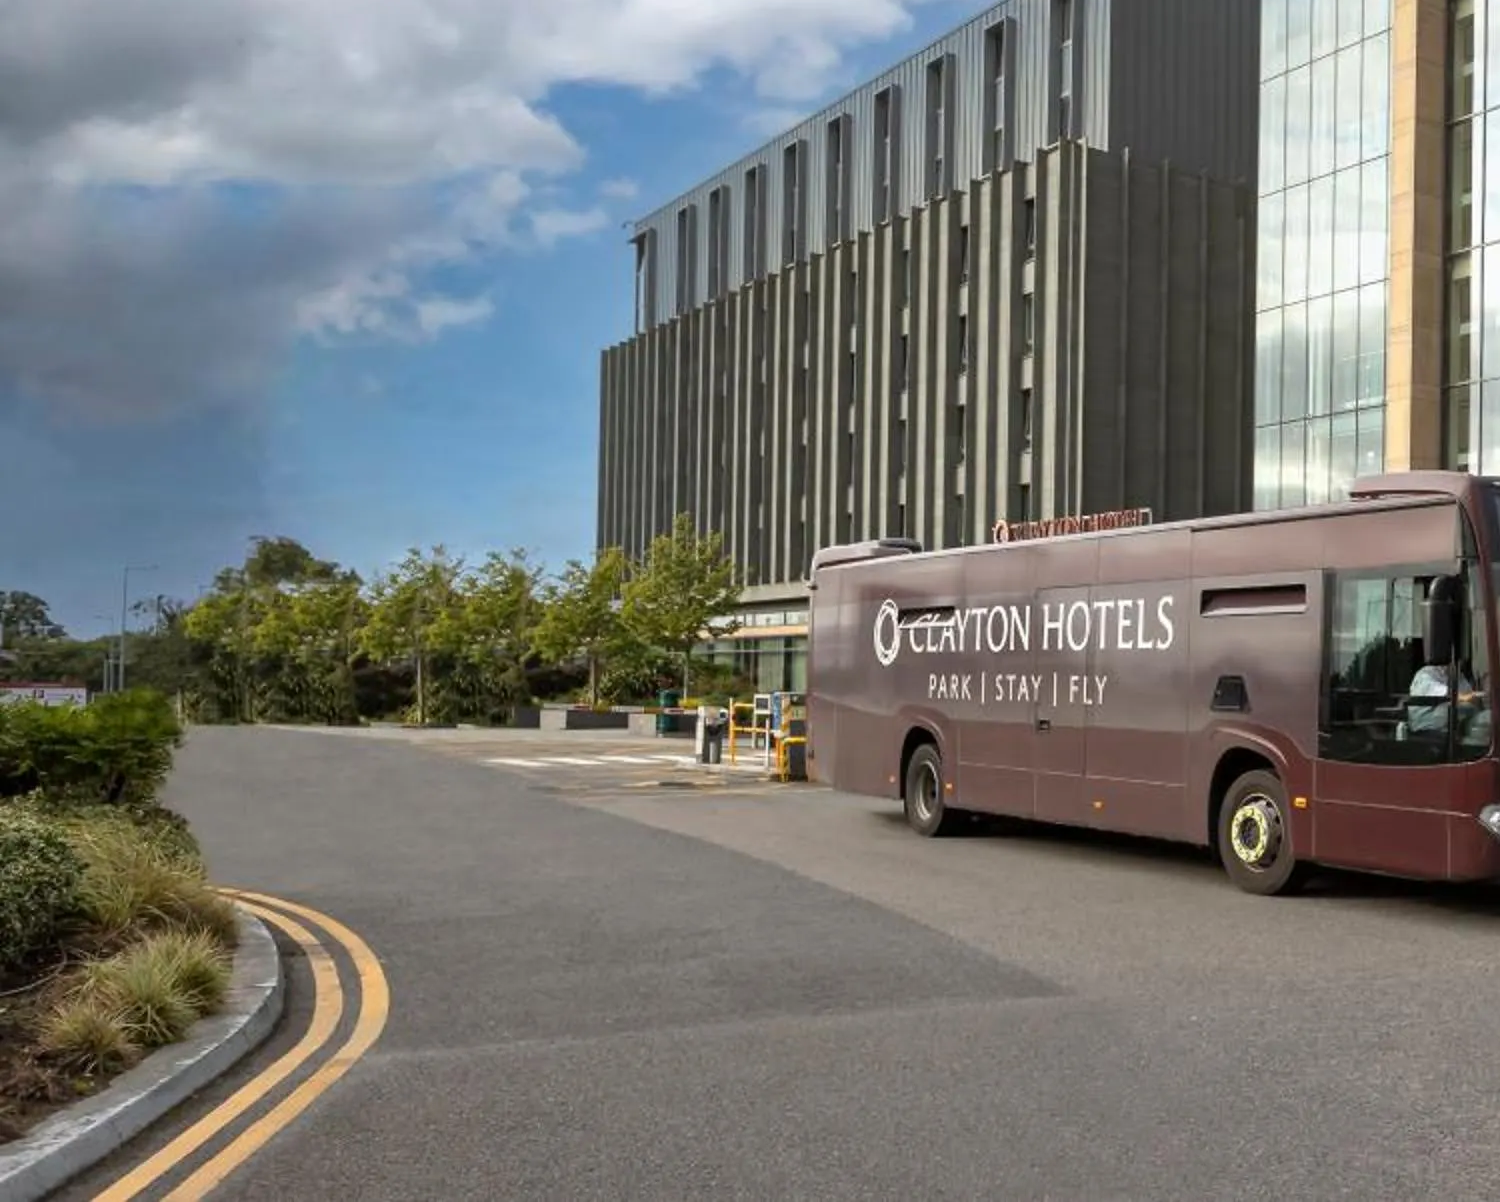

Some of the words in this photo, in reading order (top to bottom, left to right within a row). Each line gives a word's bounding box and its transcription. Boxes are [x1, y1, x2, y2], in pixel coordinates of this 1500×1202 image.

[908, 605, 1031, 653] CLAYTON
[1043, 596, 1174, 651] HOTELS
[929, 673, 972, 700] PARK
[995, 673, 1042, 701] STAY
[1069, 675, 1108, 705] FLY
